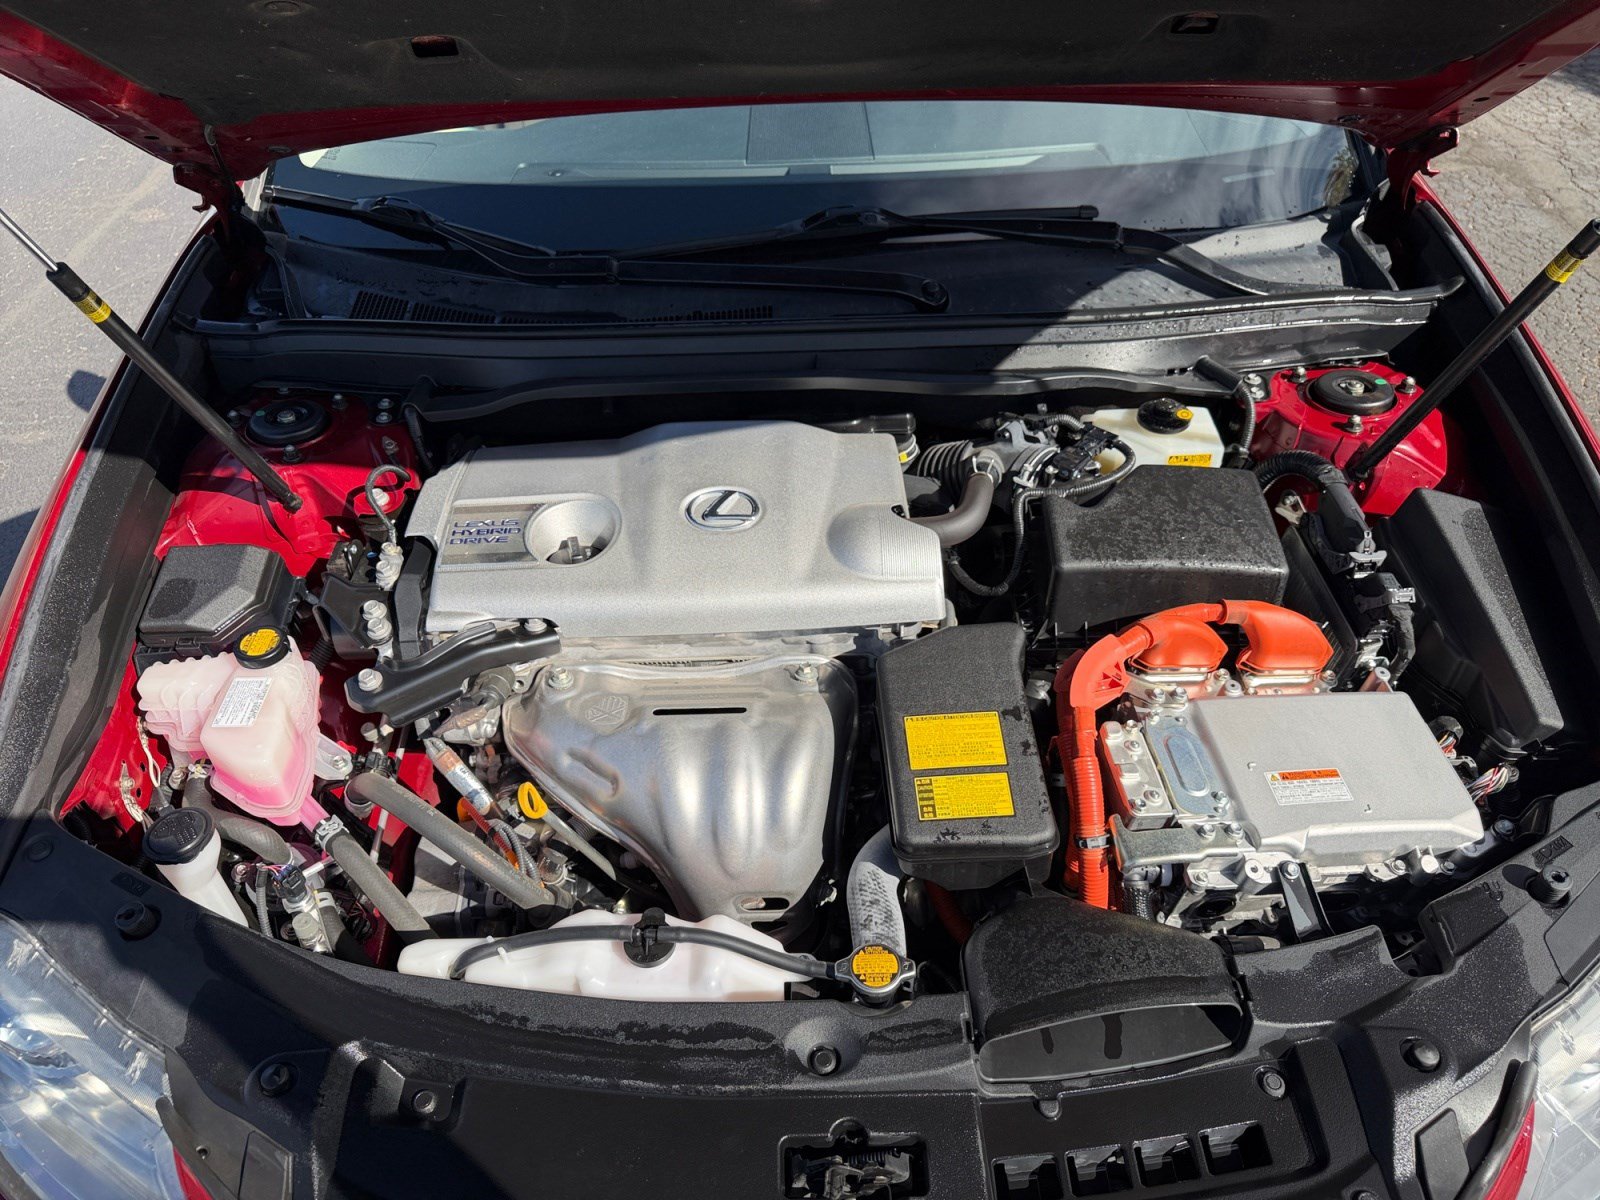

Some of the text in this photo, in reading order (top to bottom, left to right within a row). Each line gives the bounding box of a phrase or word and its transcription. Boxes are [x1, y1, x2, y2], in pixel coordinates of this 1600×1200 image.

[454, 518, 520, 528] LEXUS
[452, 527, 522, 537] HYBRID
[450, 535, 509, 545] DRIVE
